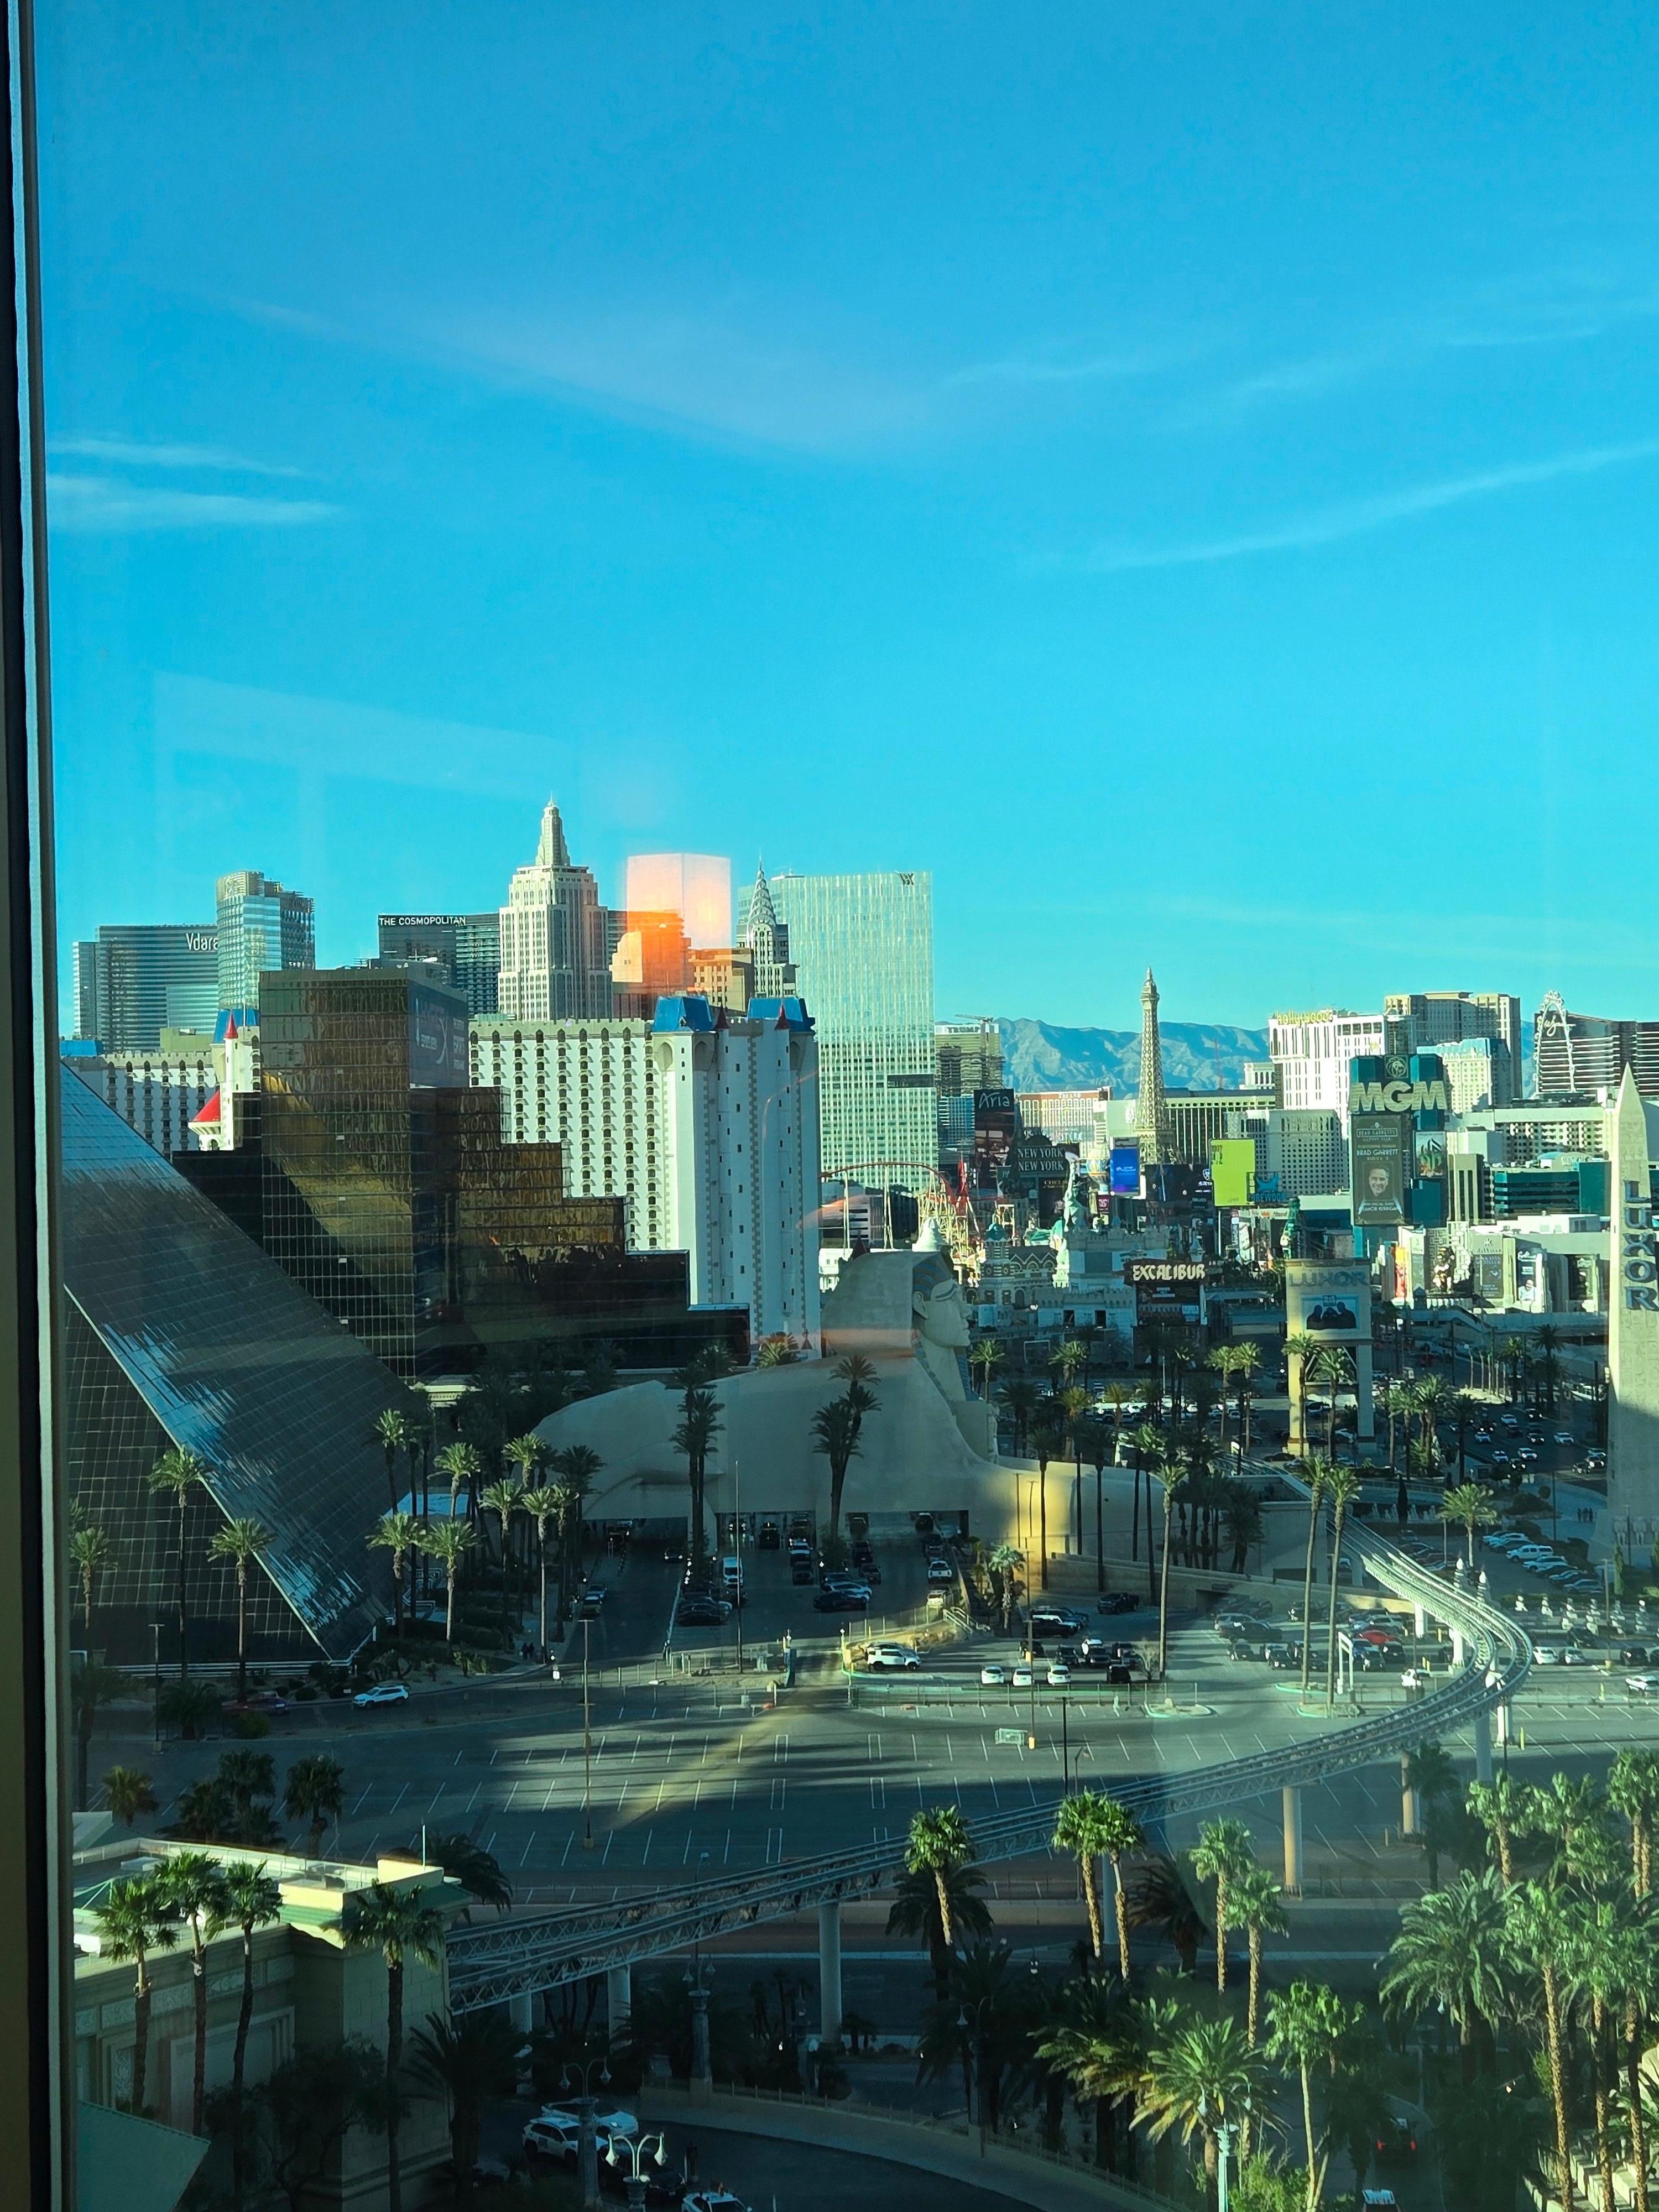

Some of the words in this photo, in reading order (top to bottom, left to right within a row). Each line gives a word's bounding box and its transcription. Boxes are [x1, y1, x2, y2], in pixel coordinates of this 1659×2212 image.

[379, 917, 396, 926] THE
[398, 916, 466, 926] COSMOPOLITAN
[186, 932, 218, 951] Vdara
[978, 1092, 1010, 1109] Aria
[1349, 1081, 1447, 1112] MGM
[1018, 1148, 1037, 1159] NEW
[1040, 1148, 1064, 1158] YORK
[1018, 1161, 1038, 1171] NEW
[1040, 1161, 1064, 1171] YORK
[1623, 1180, 1659, 1312] LUXOR
[1133, 1264, 1206, 1281] EXCALIBUR
[1289, 1271, 1370, 1287] LUXOR
